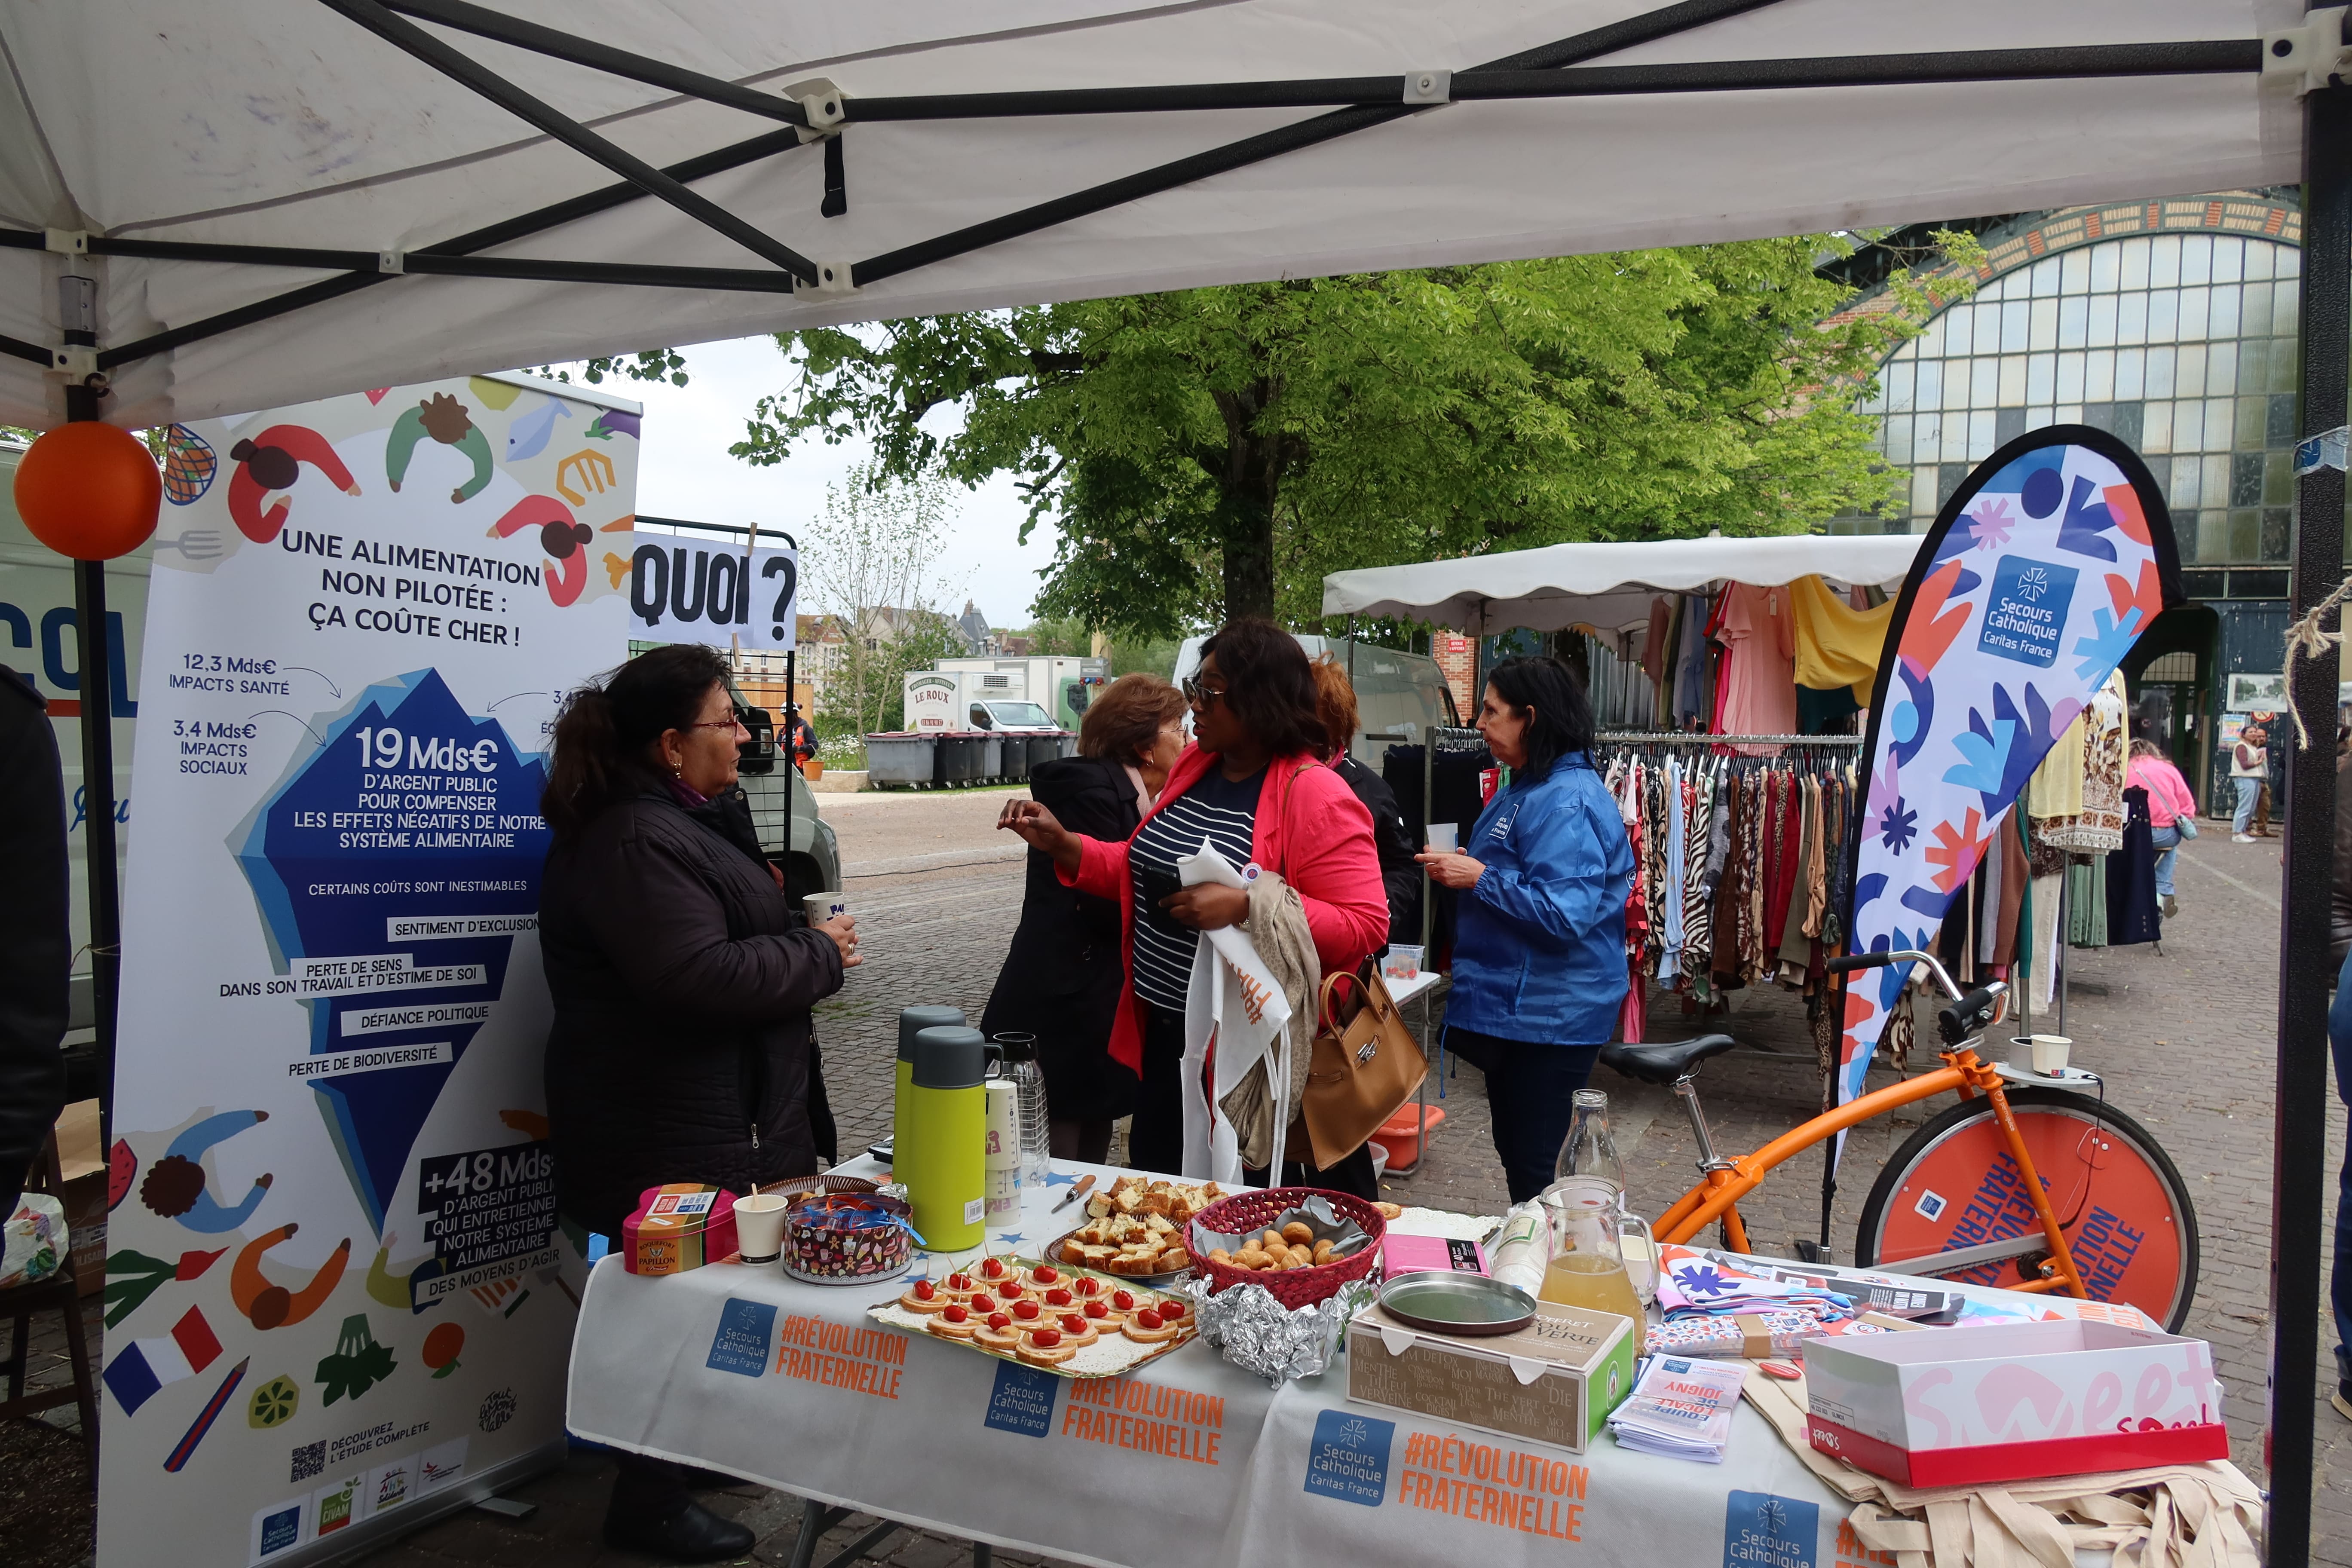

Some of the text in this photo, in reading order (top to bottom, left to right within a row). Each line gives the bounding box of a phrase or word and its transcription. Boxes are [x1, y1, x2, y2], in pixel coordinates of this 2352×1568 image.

[282, 528, 539, 587] UNE ALIMENTATION
[322, 569, 385, 597] NON
[395, 578, 493, 612] PILOTÉE
[631, 544, 796, 641] QUOI ?
[1999, 597, 2053, 622] Secours
[308, 602, 346, 630] ÇA
[355, 607, 441, 637] COÛTE
[448, 619, 508, 645] CHER
[1988, 611, 2057, 641] Catholique
[1984, 631, 2052, 658] Caritas France
[183, 654, 276, 674] 12,3 Mds€
[169, 674, 290, 695] IMPACTS SANTÉ
[915, 690, 949, 704] LE ROUX
[173, 720, 257, 739] 3,4 Mds€
[181, 741, 247, 757] IMPACTS
[356, 726, 499, 772] 19 Mds€
[180, 760, 247, 776] SOCIAUX
[364, 774, 498, 793] D'ARGENT PUBLIC
[358, 793, 496, 811] POUR COMPENSER
[294, 810, 546, 830] LES EFFETS NÉGATIFS DE NOTRE
[340, 830, 514, 848] SYSTÈME ALIMENTAIRE
[309, 880, 527, 896] CERTAINS COÛTS SONT INESTIMABLES
[395, 921, 465, 936] SENTIMENT
[306, 959, 403, 977] PERTE DE SENS
[220, 967, 477, 997] DANS SON TRAVAIL ET D'ESTIME DE SOI
[361, 1006, 489, 1029] DÉFIANCE POLITIQUE
[288, 1047, 438, 1077] PERTE DE BIODIVERSITÉ
[426, 1148, 553, 1195] +48 Mds
[444, 1178, 554, 1215] D'ARGENT PUBLI
[433, 1195, 556, 1236] QUI ENTRETIENNE
[444, 1213, 554, 1252] NOTRE SYSTÈME
[456, 1233, 545, 1267] ALIMENTAIRE
[639, 1241, 675, 1250] ROQUEFORT
[429, 1248, 560, 1296] DES MOYENS D'AGIR
[725, 1328, 761, 1344] Secours
[781, 1314, 909, 1366] #RÉVOLUTION
[1537, 1326, 1599, 1345] VERTE
[717, 1339, 765, 1357] Catholique
[712, 1353, 762, 1370] Caritas France
[1355, 1358, 1397, 1379] MENTHE
[1423, 1350, 1458, 1367] DETOX
[776, 1347, 903, 1400] FRATERNELLE
[1004, 1382, 1044, 1401] Secours
[1366, 1374, 1409, 1394] TILLEUL
[1452, 1382, 1481, 1394] RETOUR
[1664, 1381, 1724, 1400] JOIGNY
[484, 1387, 511, 1403] Tout
[994, 1394, 1048, 1416] Catholique
[1360, 1384, 1412, 1408] VERVEINE
[1415, 1392, 1458, 1410] COCKTAIL
[1511, 1395, 1540, 1409] VERT
[1549, 1388, 1572, 1407] DIE
[1694, 1397, 1719, 1409] DE
[1426, 1403, 1455, 1418] DIGEST
[1492, 1406, 1540, 1427] MENTHE
[1543, 1404, 1556, 1416] CA
[1649, 1405, 1709, 1422] EQUIPE
[1654, 1398, 1715, 1416] LOCALE
[990, 1410, 1045, 1430] Caritas France
[1548, 1416, 1564, 1427] MO
[330, 1421, 430, 1464] L'ÉTUDE COMPLÈTE
[331, 1421, 393, 1451] DÉCOUVREZ
[1062, 1405, 1222, 1465] FRATERNELLE
[1546, 1426, 1571, 1441] MILLE
[1323, 1444, 1375, 1466] Secours
[1314, 1456, 1381, 1483] Catholique
[1404, 1432, 1589, 1500] #RÉVOLUTION
[1311, 1474, 1379, 1498] Caritas France
[323, 1503, 349, 1523] CIVAM
[1399, 1470, 1584, 1542] FRATERNELLE
[264, 1528, 296, 1544] Catholique
[268, 1524, 293, 1537] Secours
[1741, 1528, 1800, 1555] Secours
[1730, 1543, 1810, 1568] Catholique
